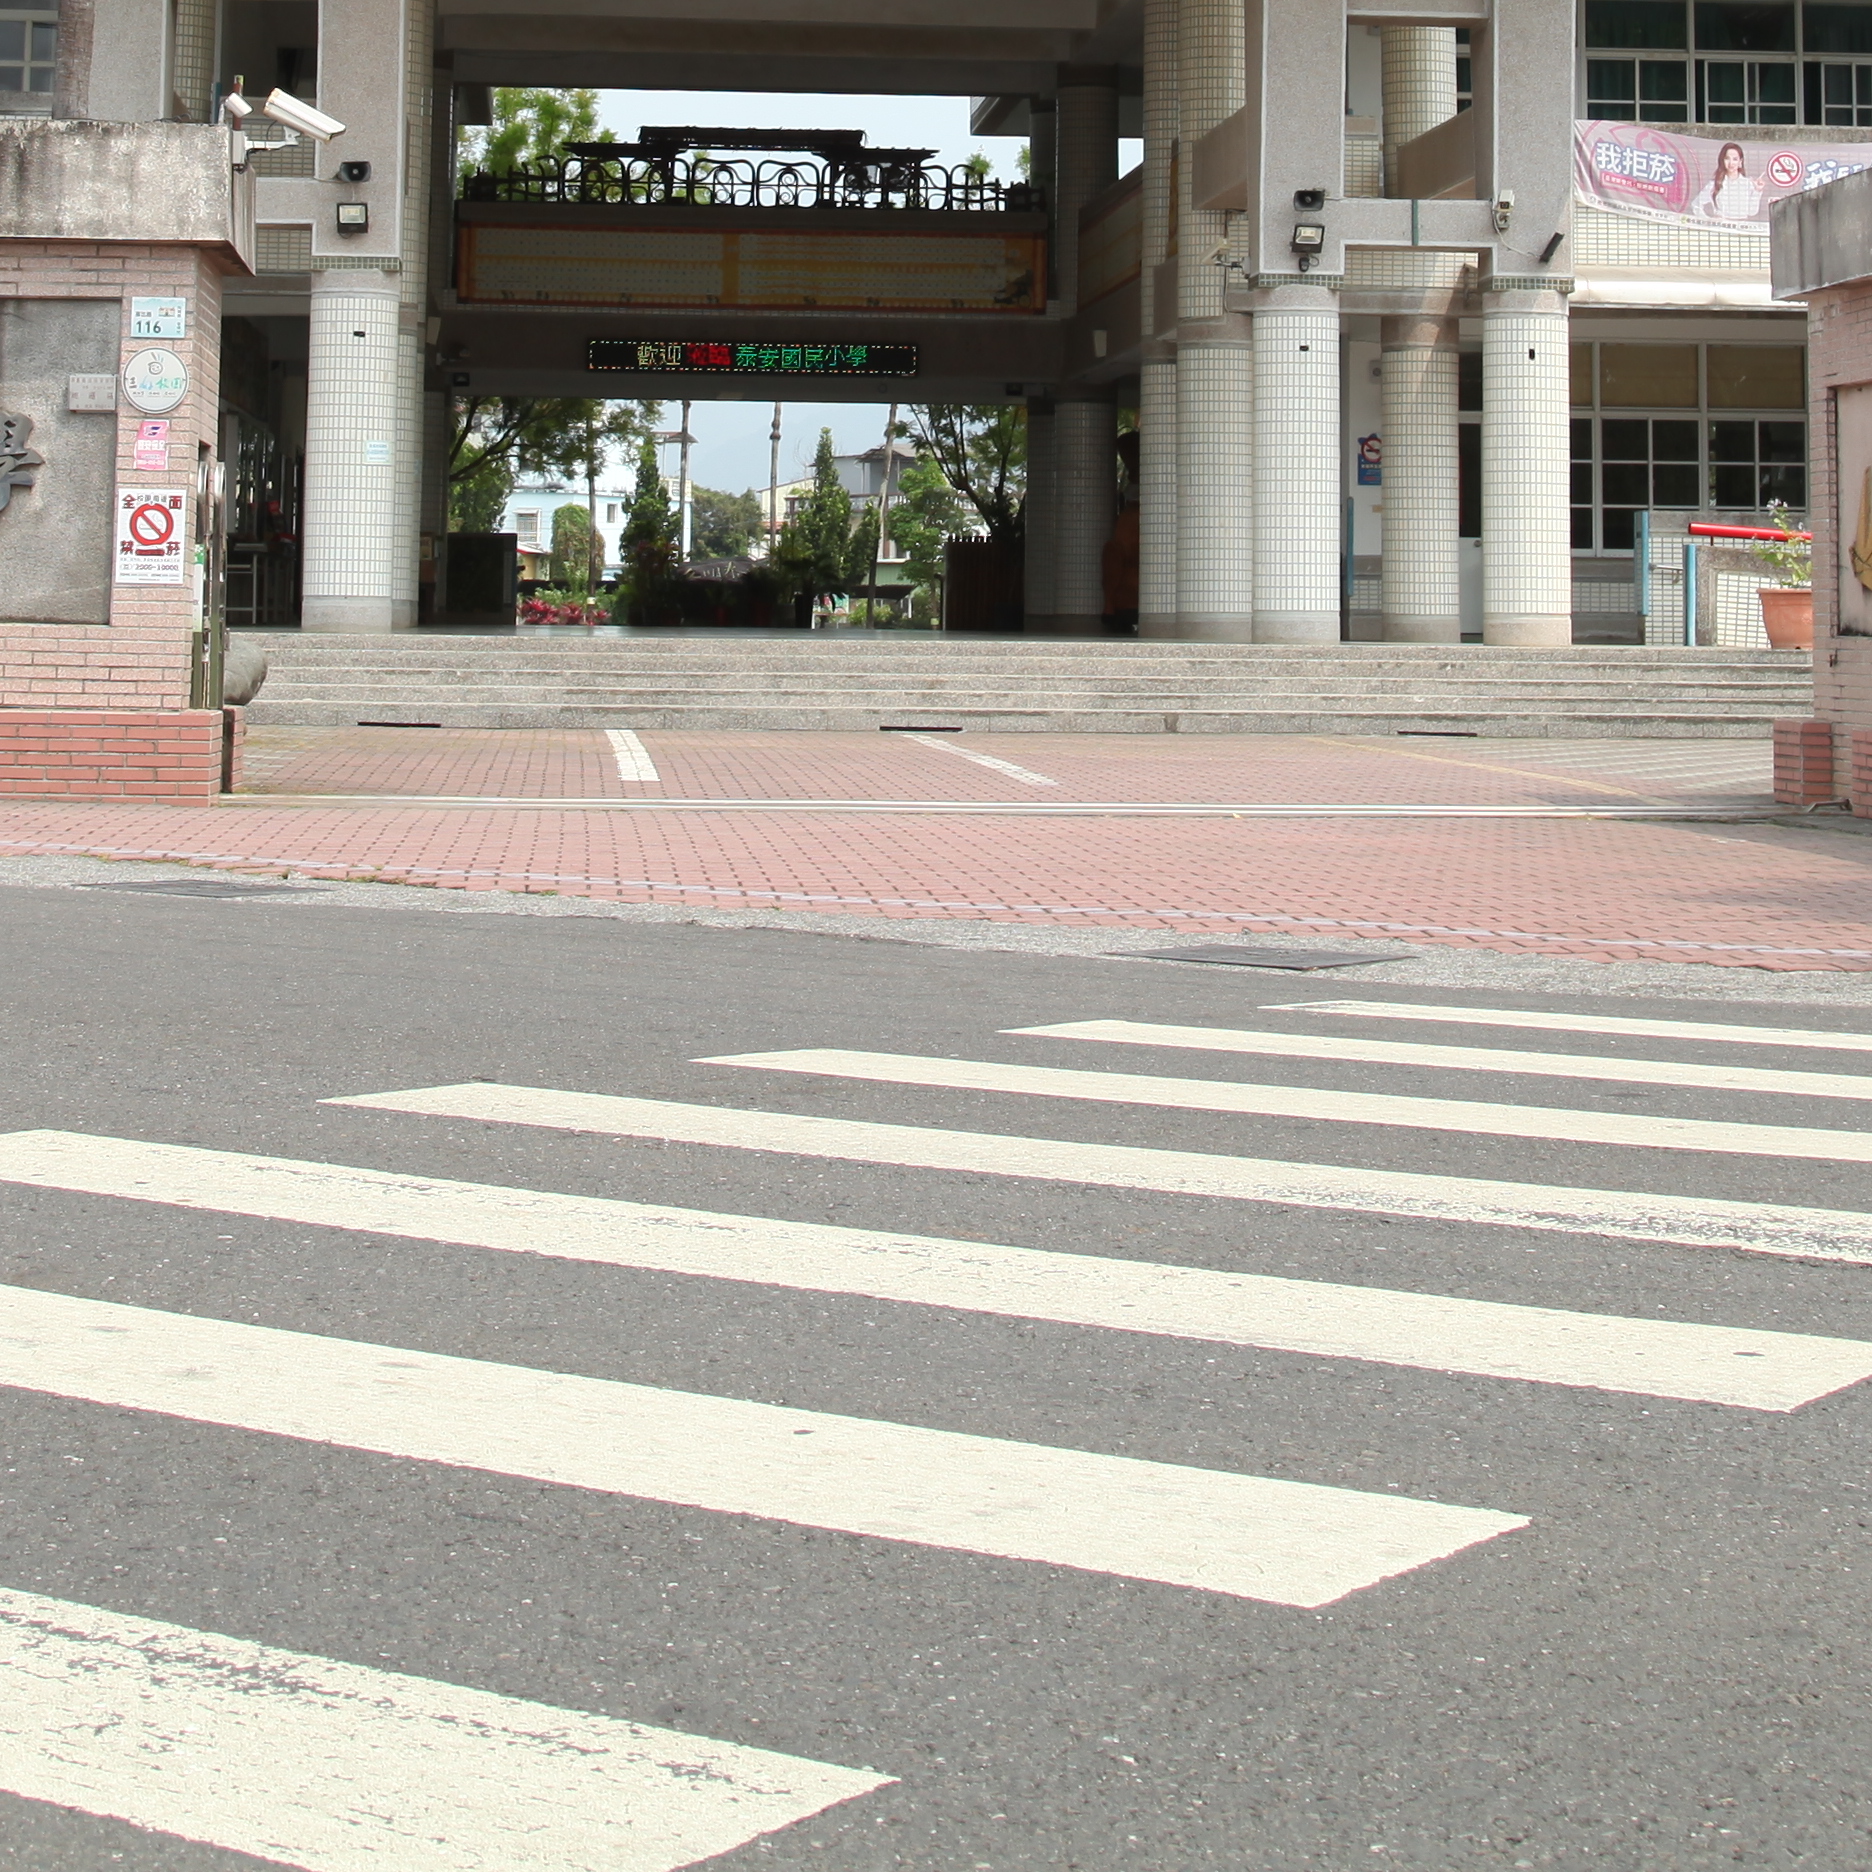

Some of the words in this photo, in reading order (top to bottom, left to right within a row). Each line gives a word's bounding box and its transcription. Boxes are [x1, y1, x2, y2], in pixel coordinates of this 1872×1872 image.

[1595, 141, 1676, 184] 我拒菸
[136, 320, 162, 334] 116
